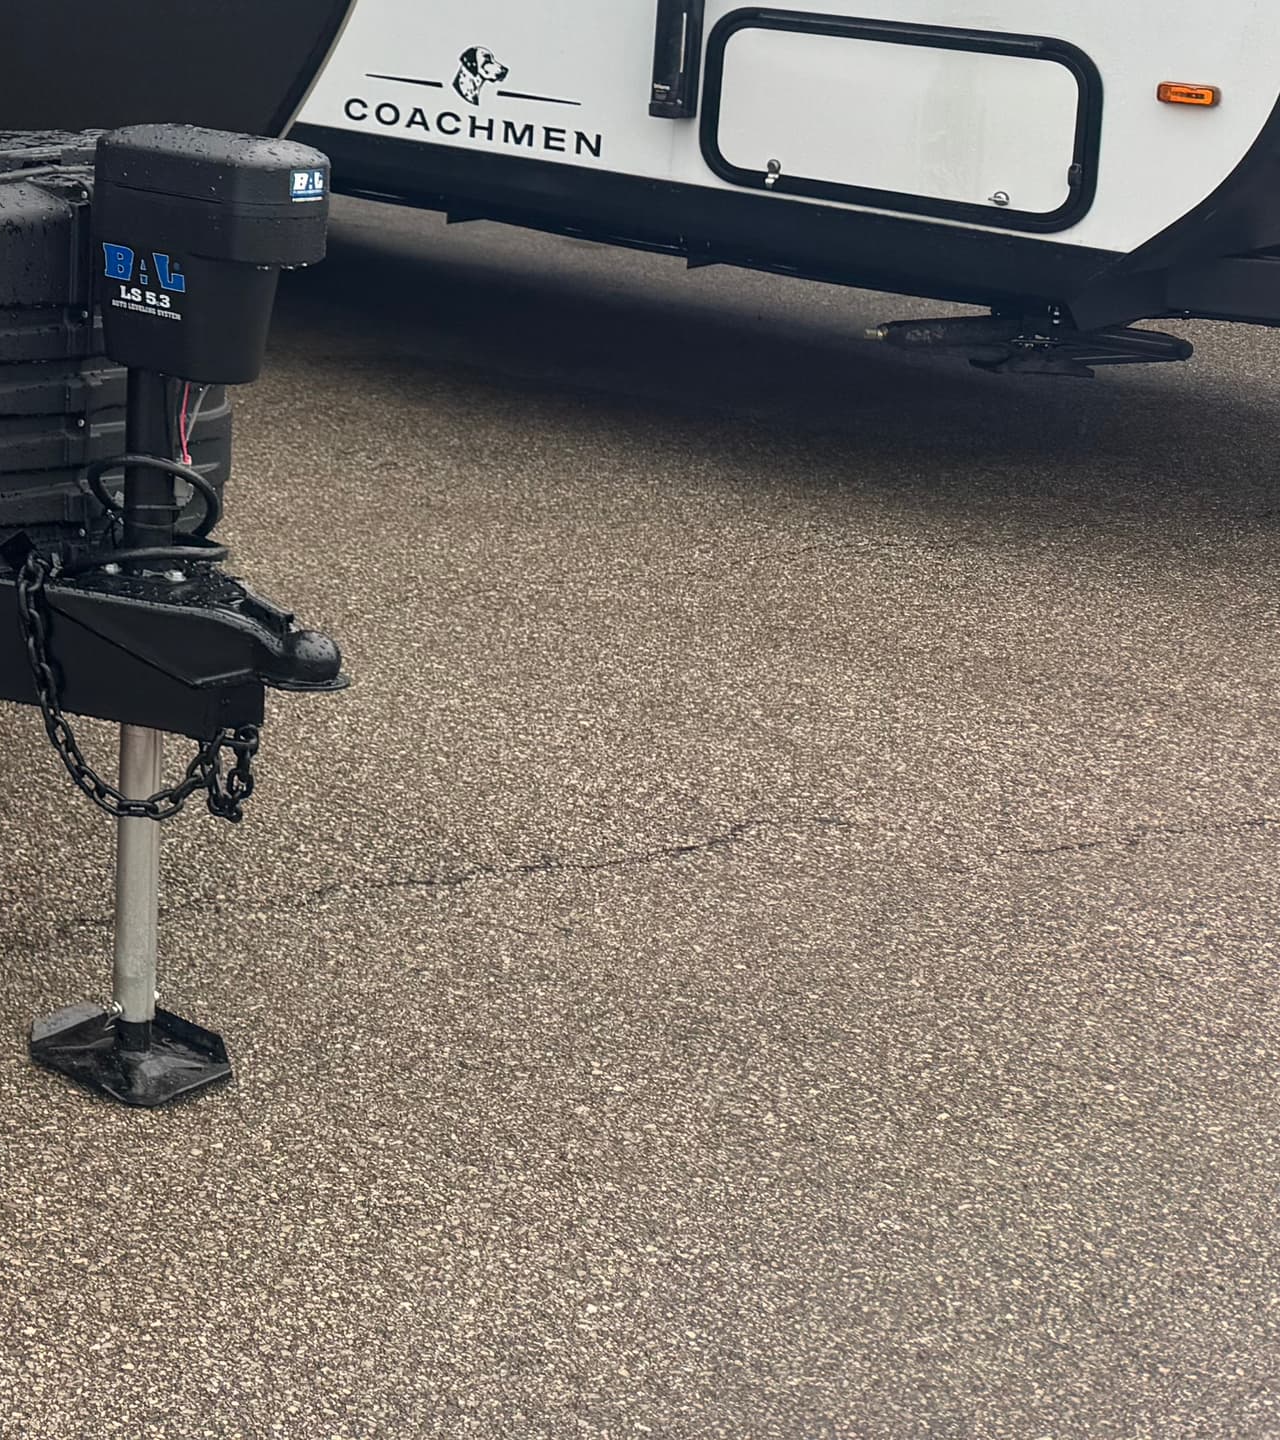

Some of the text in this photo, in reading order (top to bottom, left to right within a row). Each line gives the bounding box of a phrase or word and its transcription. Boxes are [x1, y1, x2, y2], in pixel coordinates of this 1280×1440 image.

[344, 97, 603, 158] COACHMEN
[102, 242, 186, 293] BAL
[119, 284, 172, 309] LS 5.3
